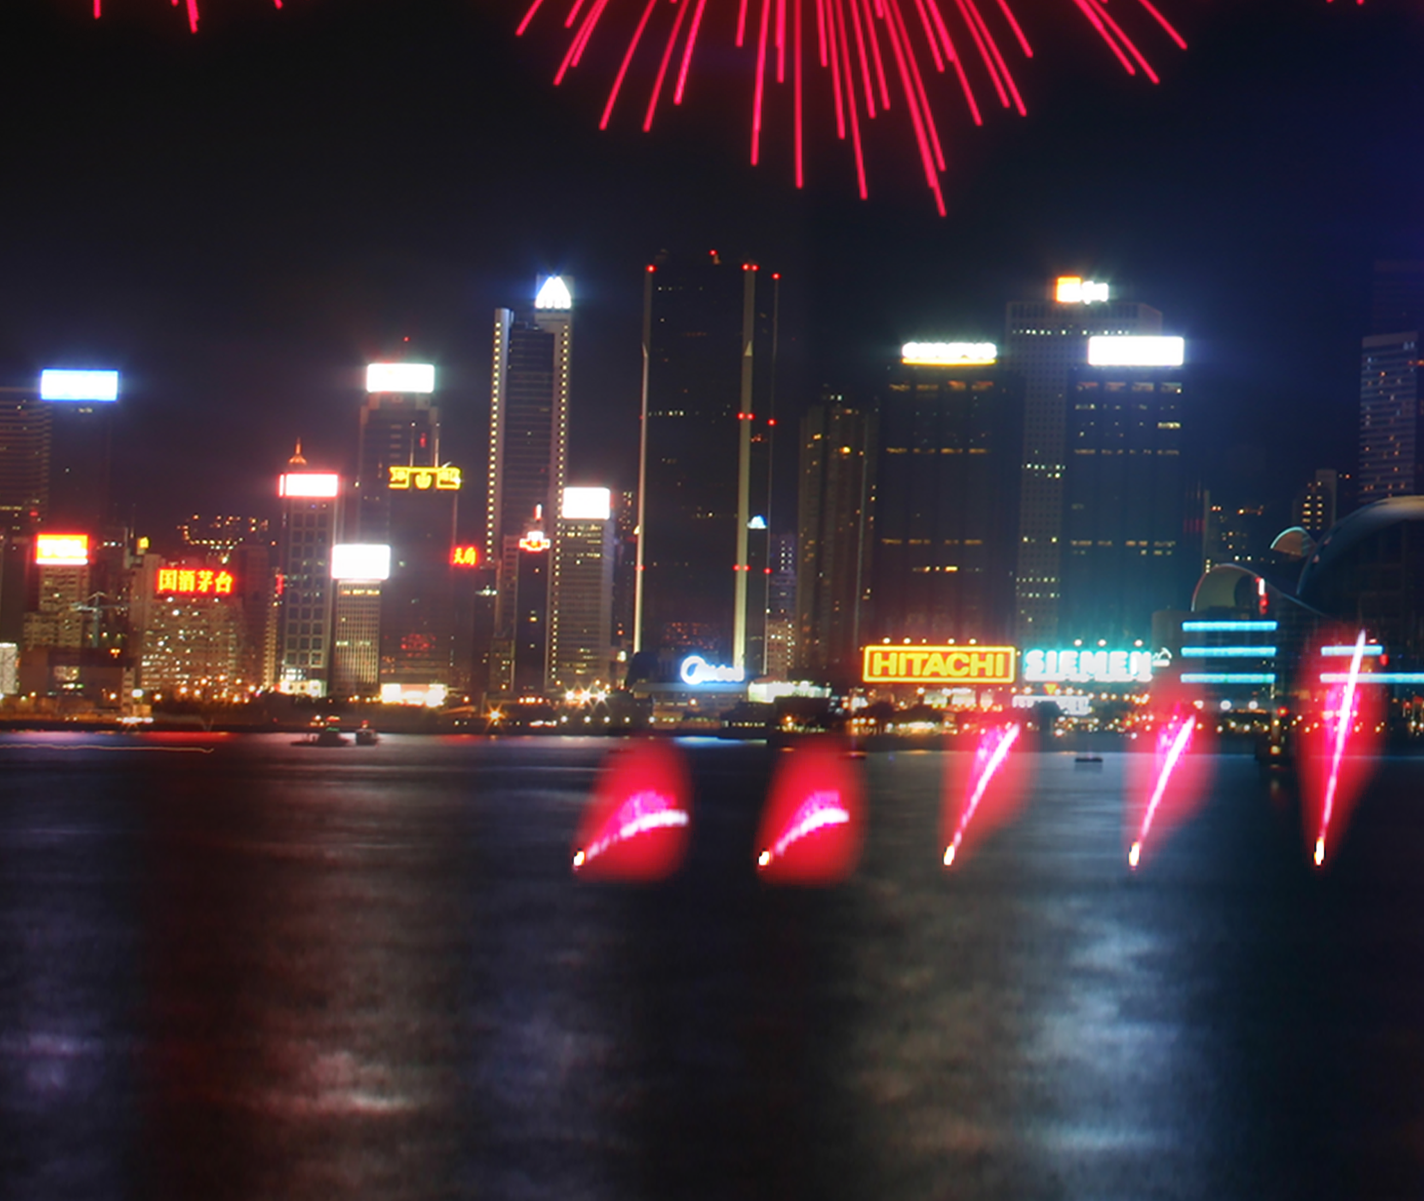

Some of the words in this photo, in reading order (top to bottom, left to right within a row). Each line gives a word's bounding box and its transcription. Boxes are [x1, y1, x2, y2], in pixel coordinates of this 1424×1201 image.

[158, 568, 233, 593] 国酒茅台
[872, 652, 1004, 677] HITACHI
